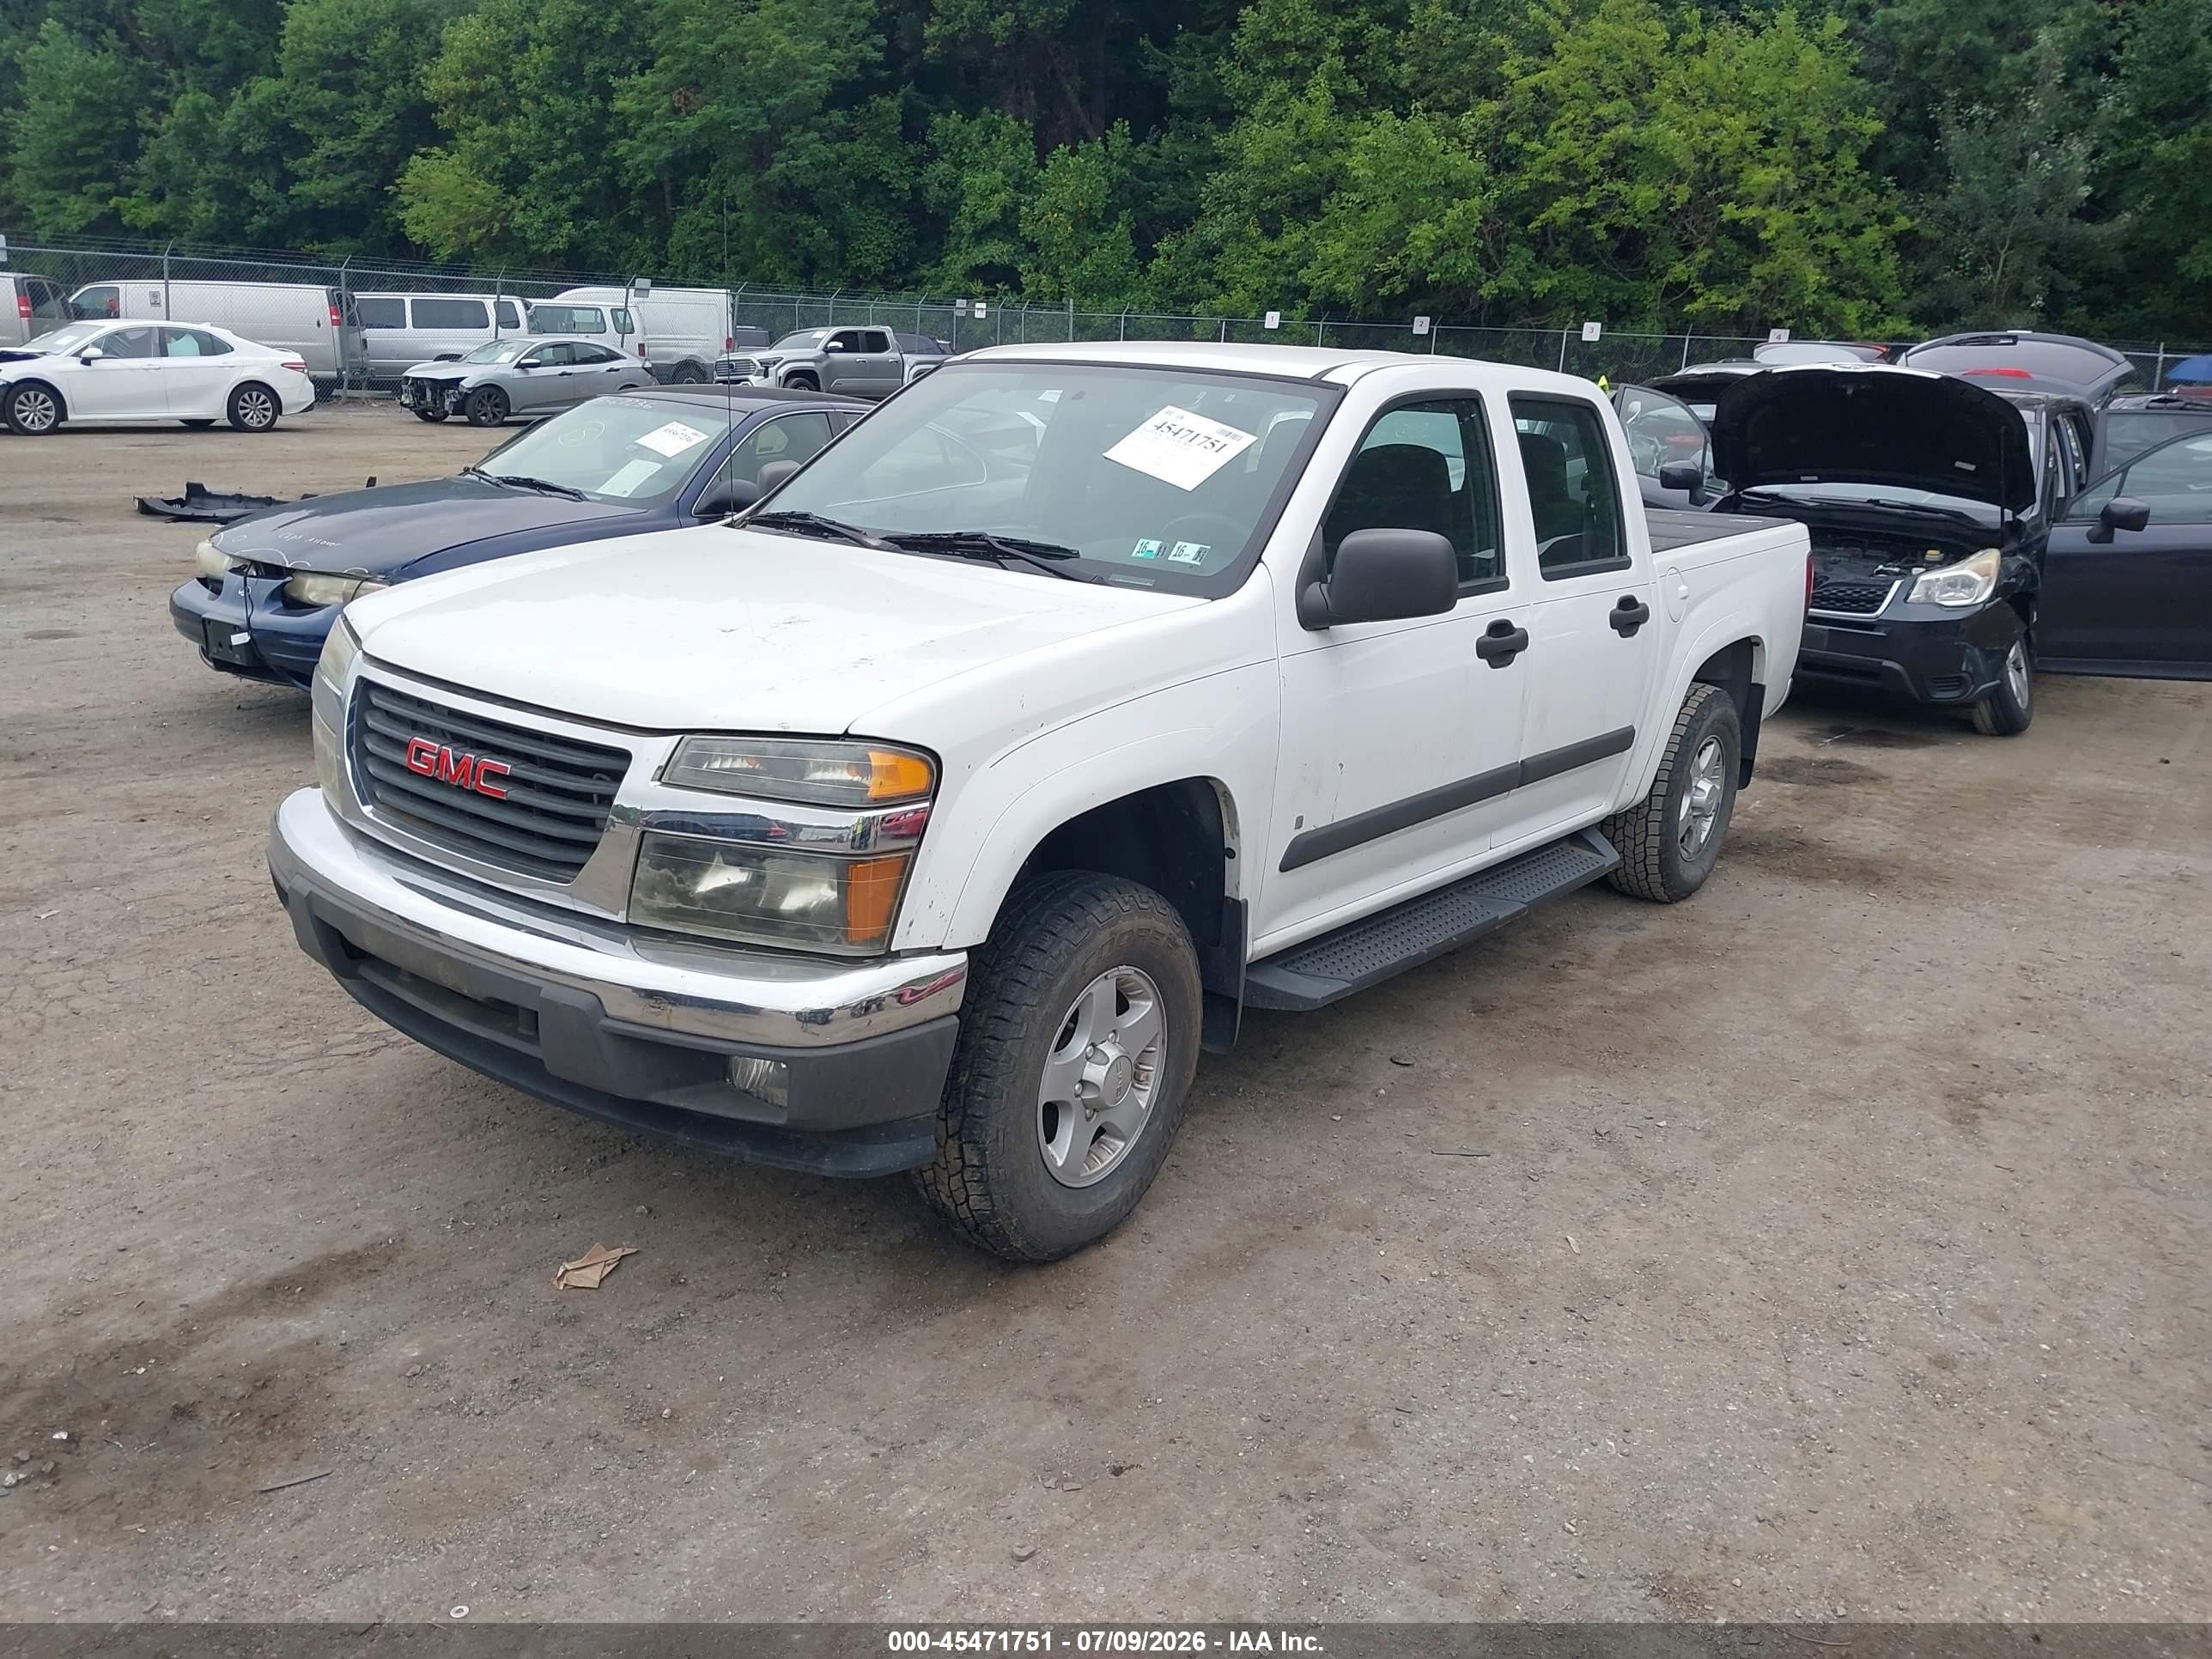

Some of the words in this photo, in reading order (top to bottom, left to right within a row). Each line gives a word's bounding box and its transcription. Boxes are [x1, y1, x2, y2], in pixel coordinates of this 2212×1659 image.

[1154, 421, 1228, 453] 45471751
[1135, 541, 1150, 555] 16
[1173, 544, 1187, 557] 16
[405, 736, 512, 801] GMC
